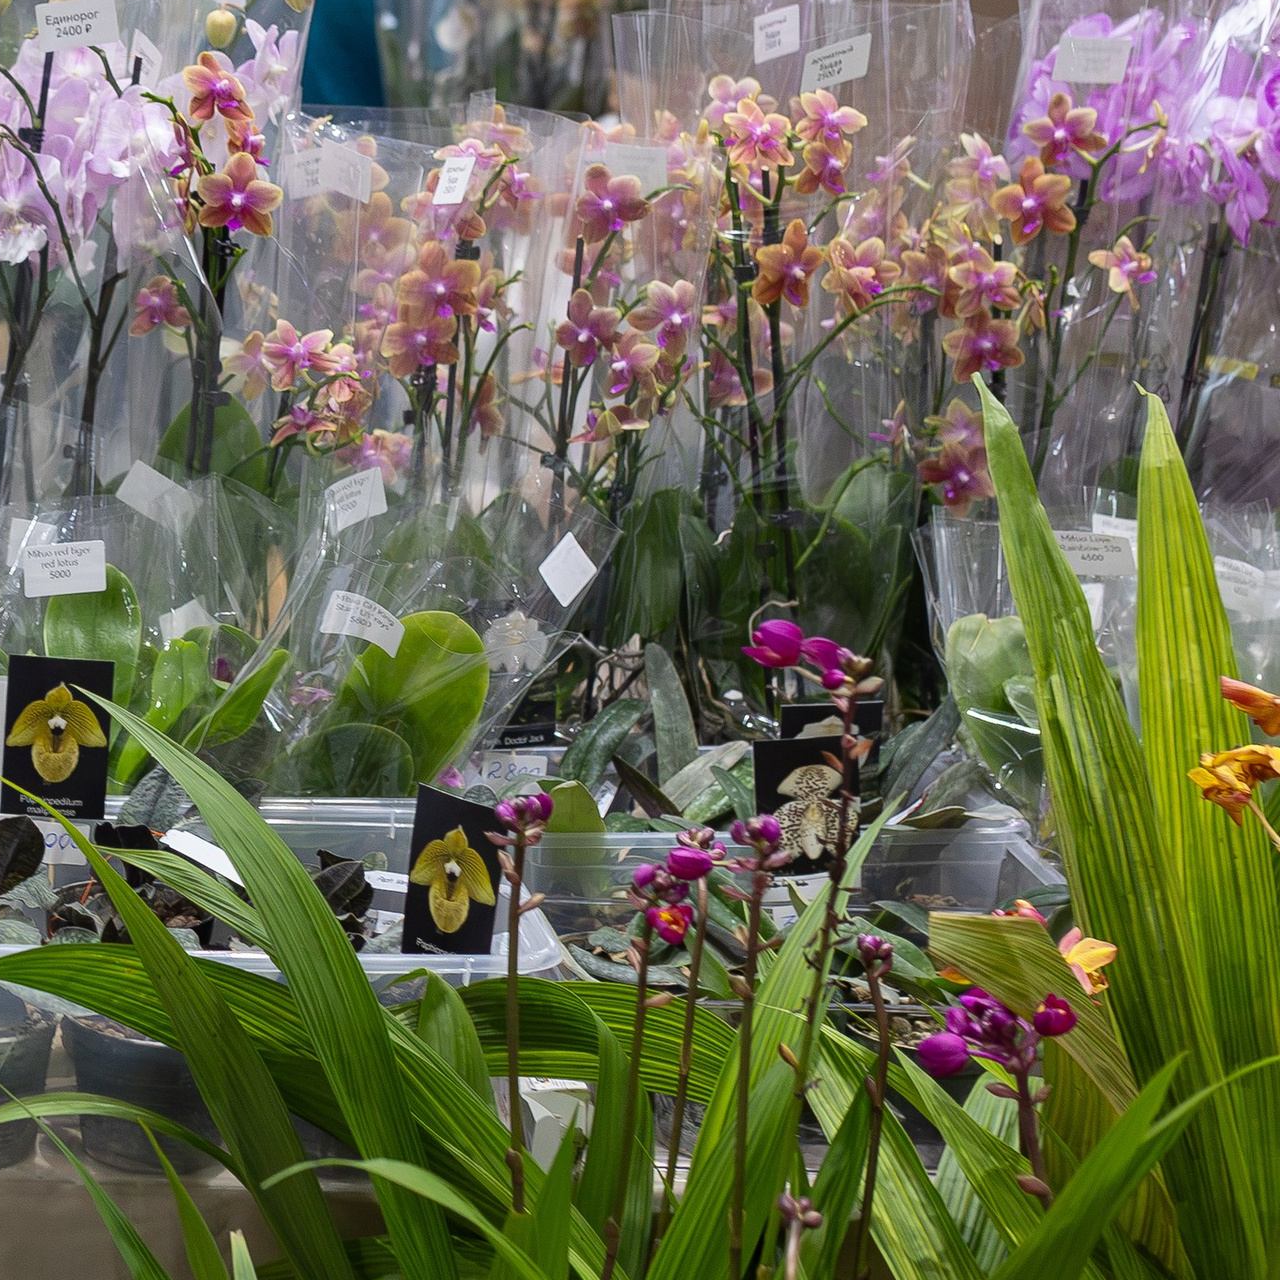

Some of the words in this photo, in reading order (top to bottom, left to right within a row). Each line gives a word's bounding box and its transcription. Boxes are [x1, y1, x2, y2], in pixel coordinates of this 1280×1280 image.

[44, 10, 100, 27] Единорог
[55, 25, 83, 39] 2400
[54, 547, 69, 557] red
[70, 545, 91, 558] tiger
[40, 560, 55, 570] red
[57, 559, 80, 568] lotus
[504, 733, 528, 746] Doctor
